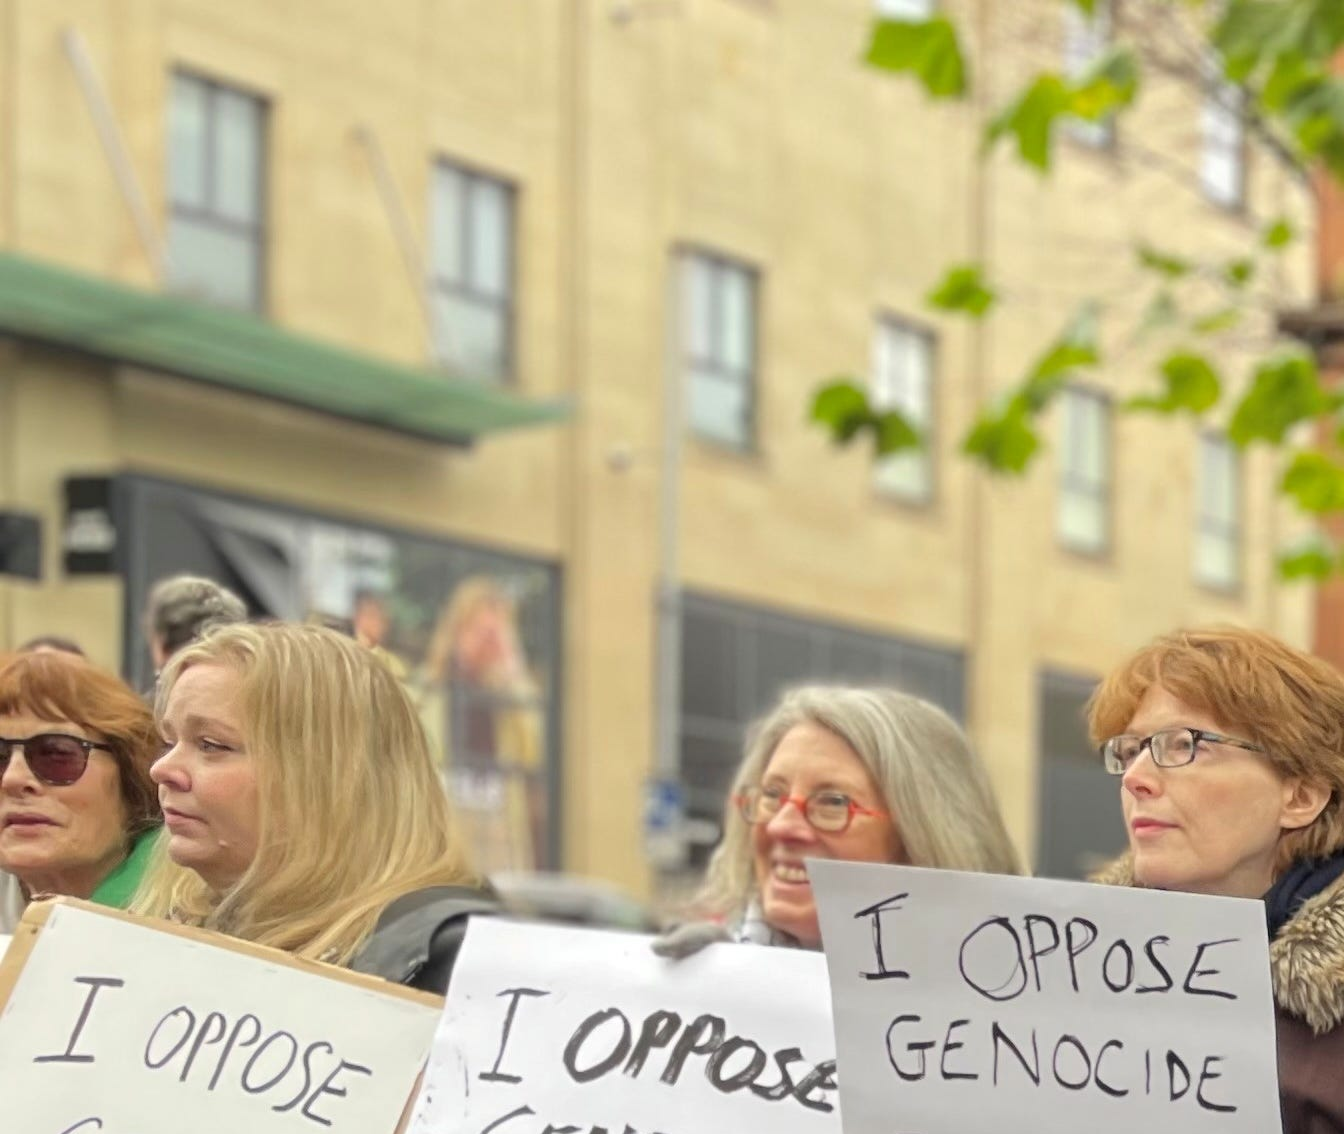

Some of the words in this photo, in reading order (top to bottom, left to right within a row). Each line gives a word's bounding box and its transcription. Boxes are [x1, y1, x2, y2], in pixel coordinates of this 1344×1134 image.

[854, 892, 910, 981] I
[958, 914, 1240, 1001] OPPOSE
[34, 975, 123, 1064] I
[143, 1005, 372, 1127] OPPOSE
[478, 986, 551, 1085] I
[562, 1006, 838, 1113] OPPOSE
[885, 1014, 1238, 1112] GENOCIDE
